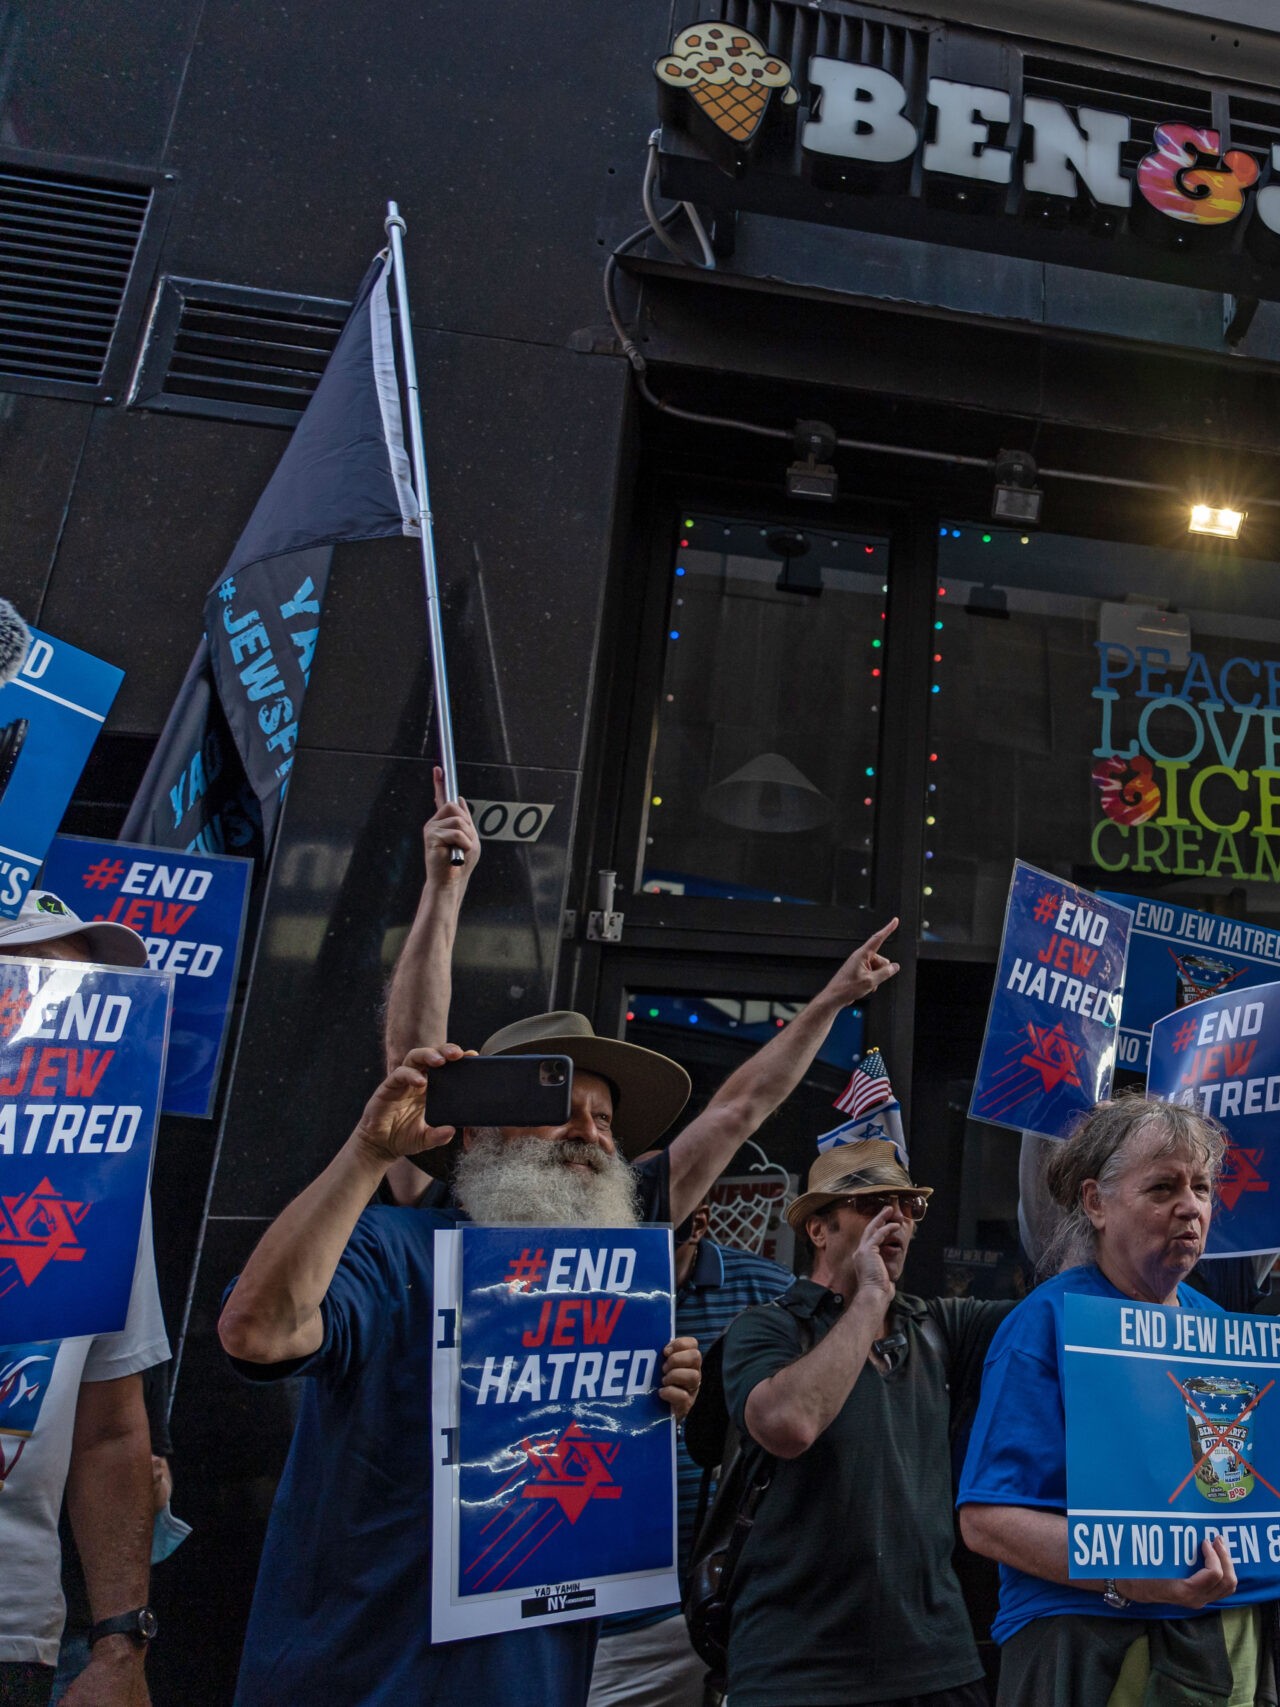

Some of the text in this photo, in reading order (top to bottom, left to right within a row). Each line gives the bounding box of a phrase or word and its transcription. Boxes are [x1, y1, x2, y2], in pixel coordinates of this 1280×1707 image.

[803, 55, 1131, 208] BEN
[1136, 121, 1260, 226] &
[468, 802, 543, 838] 00
[82, 858, 214, 902] #END
[92, 897, 197, 935] JEW
[1034, 893, 1110, 947] #END
[1135, 902, 1175, 932] END
[1176, 915, 1217, 941] JEW
[1038, 935, 1099, 978] JEW
[1006, 957, 1112, 1023] HATRED
[1172, 1001, 1266, 1052] #END
[0, 1046, 115, 1098] JEW
[1181, 1040, 1258, 1086] JEW
[504, 1248, 637, 1294] #END
[521, 1298, 627, 1349] JEW
[1120, 1307, 1167, 1348] END
[1173, 1315, 1218, 1354] JEW
[476, 1350, 658, 1405] HATRED
[1073, 1523, 1125, 1566] SAY
[1132, 1525, 1164, 1566] NO
[1170, 1525, 1198, 1566] TO
[534, 1582, 581, 1598] YAD YAMIN
[547, 1595, 568, 1612] NY
